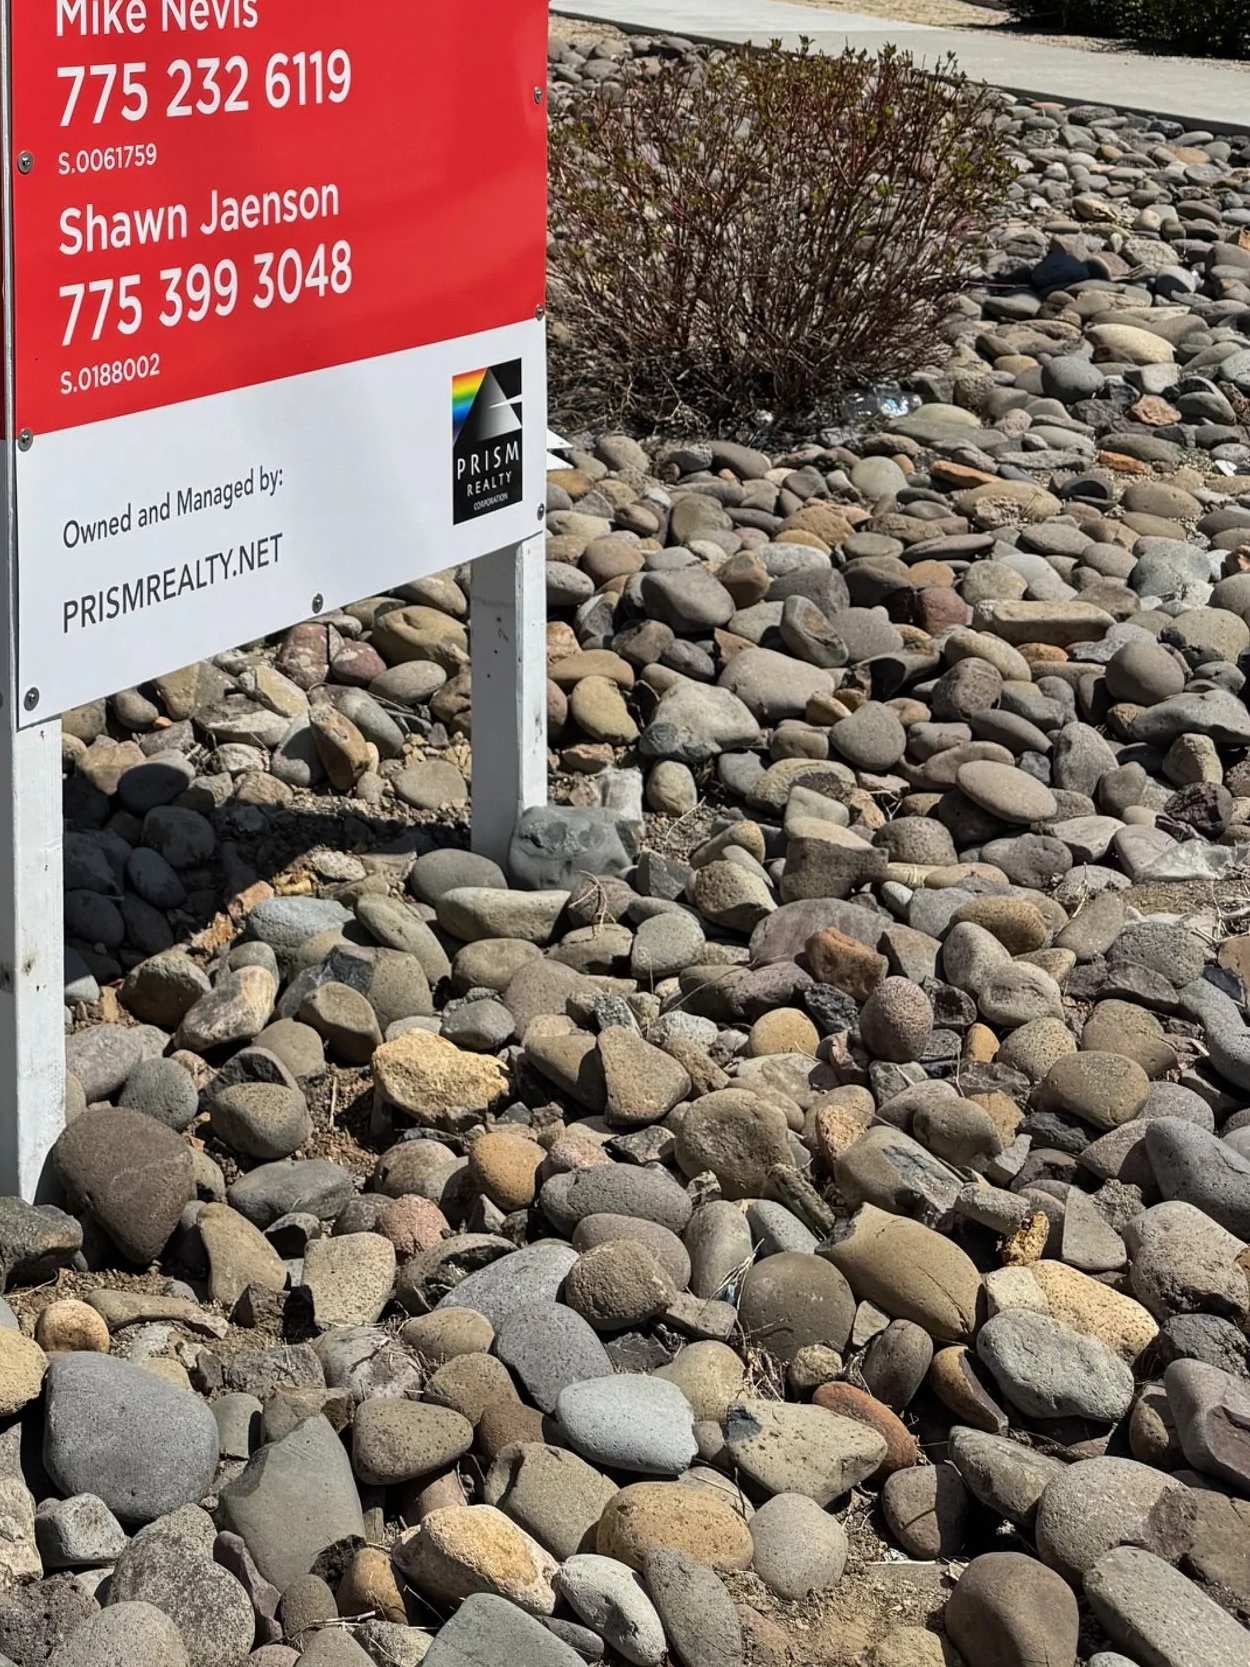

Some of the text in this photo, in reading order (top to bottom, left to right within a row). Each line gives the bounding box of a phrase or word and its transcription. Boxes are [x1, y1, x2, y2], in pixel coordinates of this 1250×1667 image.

[57, 49, 350, 127] 775 232 6119
[59, 144, 156, 175] S.0061759
[59, 183, 339, 255] Shawn Jaenson
[59, 240, 350, 346] 775 399 3048
[61, 353, 160, 394] S.0188002
[458, 441, 519, 480] PRISM
[467, 471, 511, 497] REALTY
[63, 467, 283, 549] Owned and Managed by:
[474, 493, 508, 510] CORPORATION
[64, 534, 283, 633] PRISMREALTY.NET
